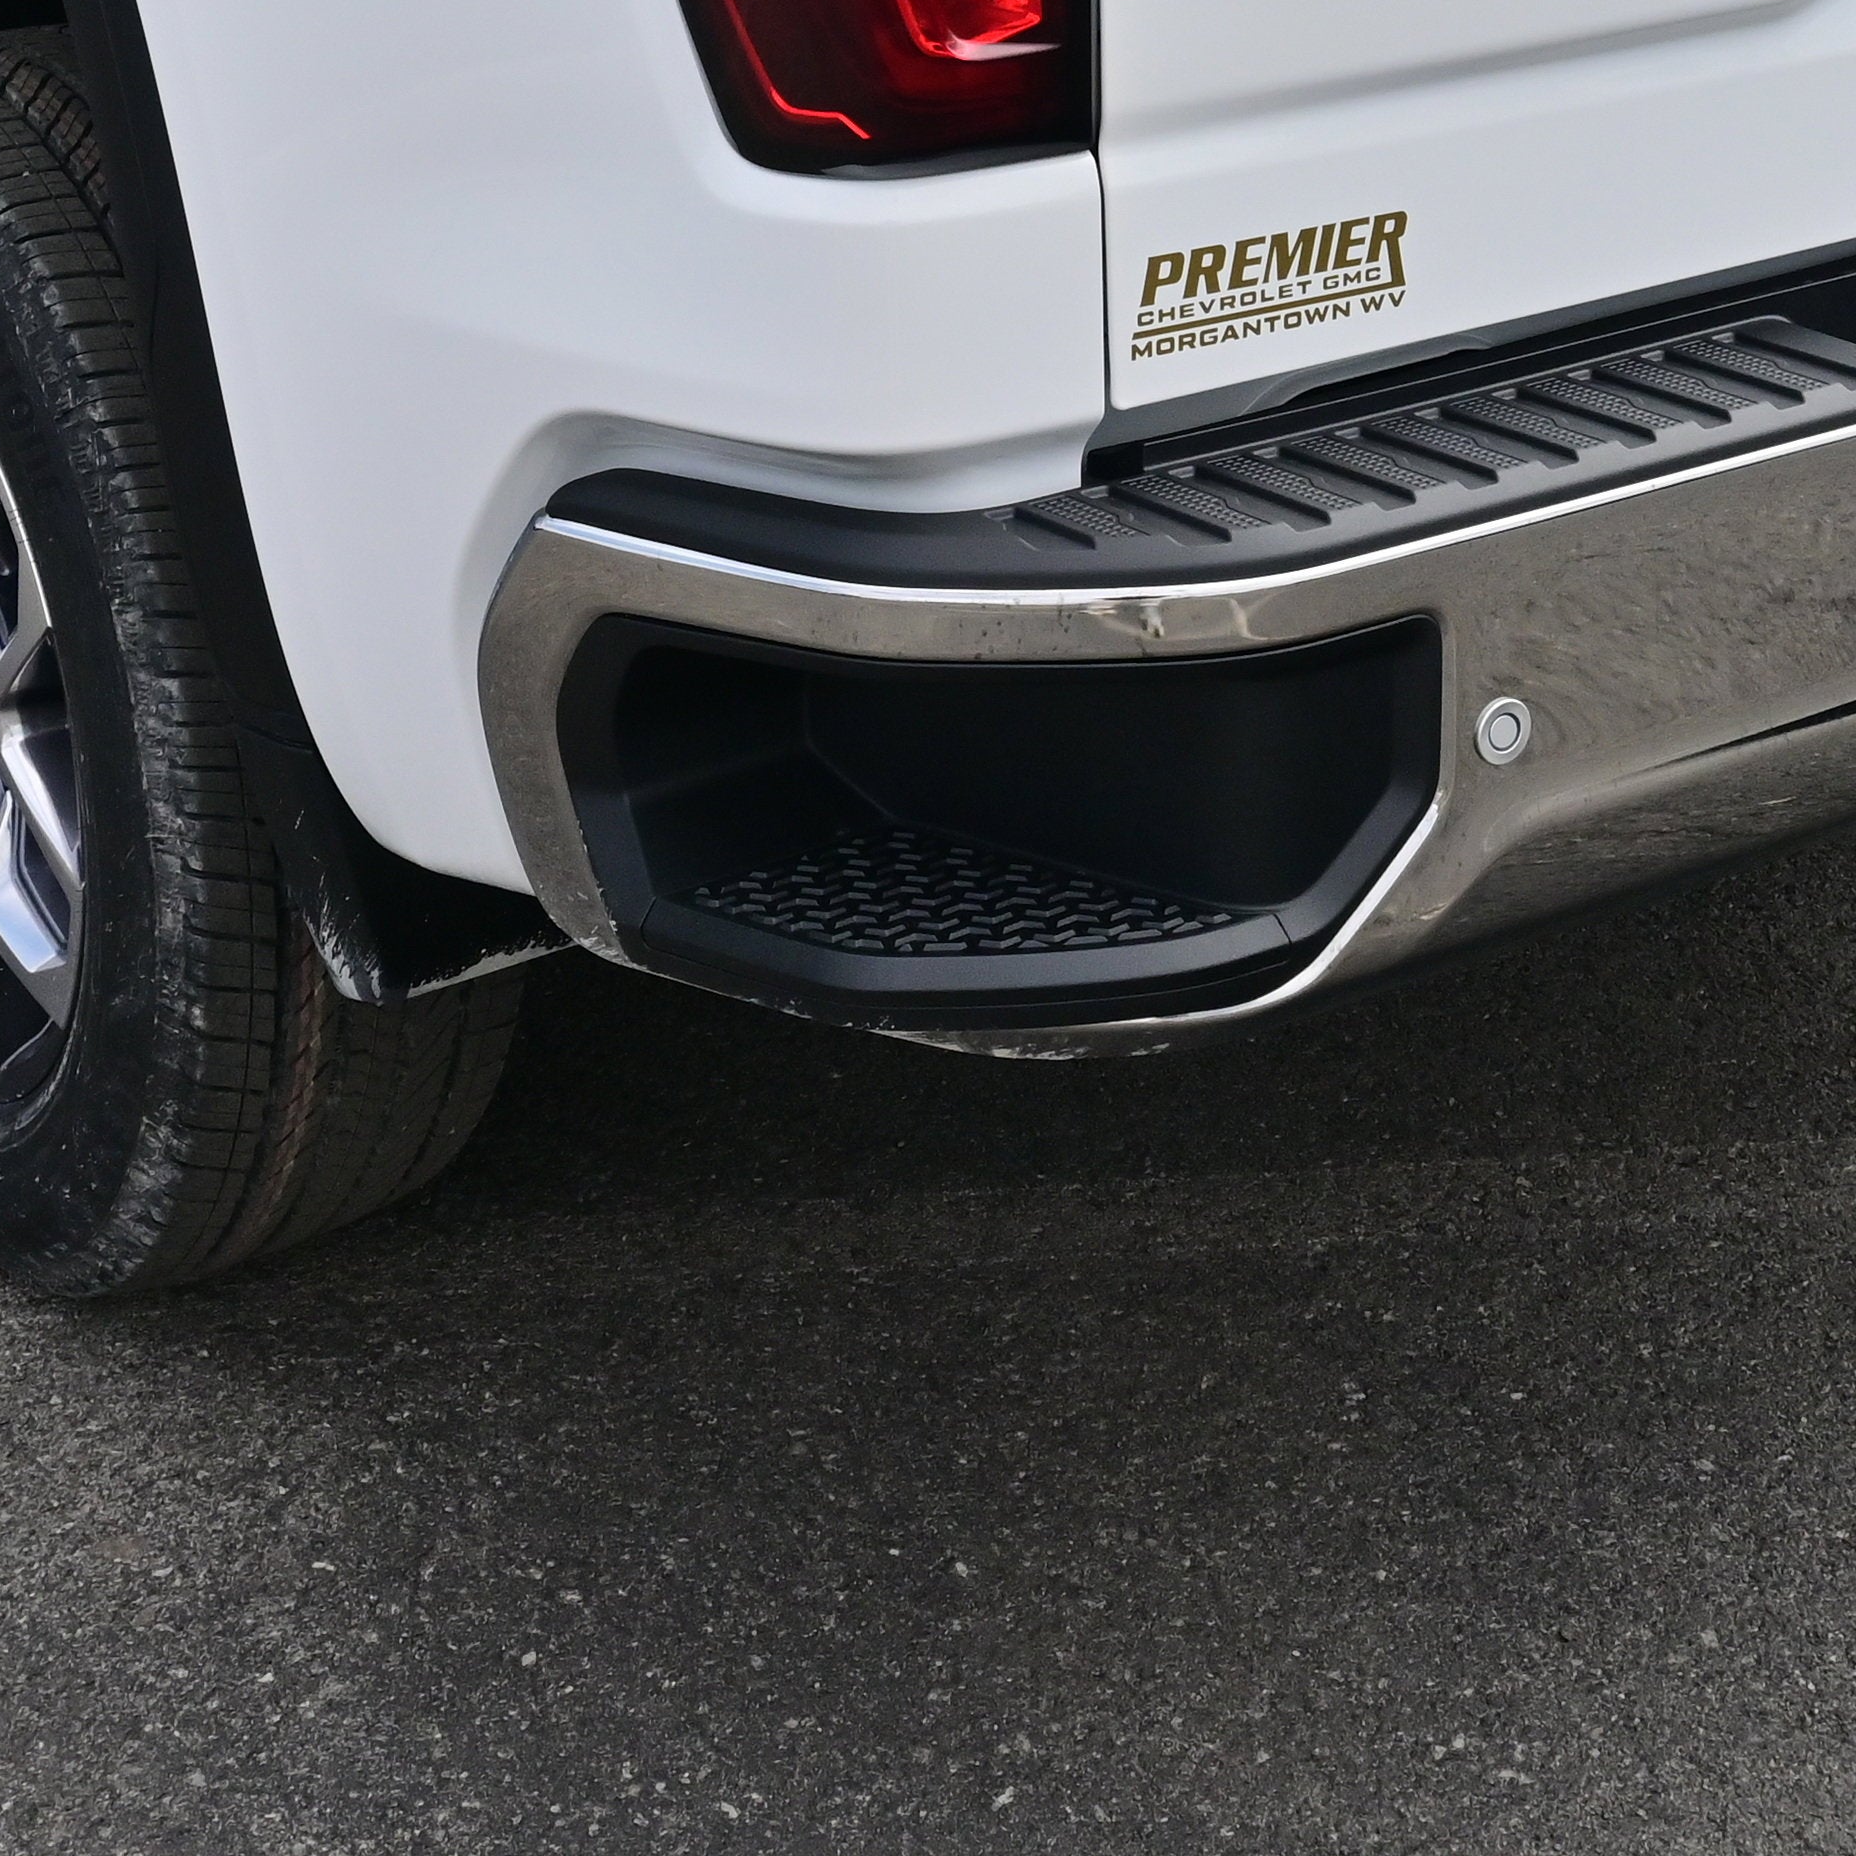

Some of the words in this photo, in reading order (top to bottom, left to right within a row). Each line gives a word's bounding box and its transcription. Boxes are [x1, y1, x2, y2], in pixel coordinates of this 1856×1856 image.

[1140, 210, 1408, 307] PREMIER
[1130, 301, 1351, 361] MORGANTOWN
[1359, 290, 1407, 313] WV
[1136, 279, 1312, 327] CHEVROLET
[1322, 266, 1383, 291] GMC
